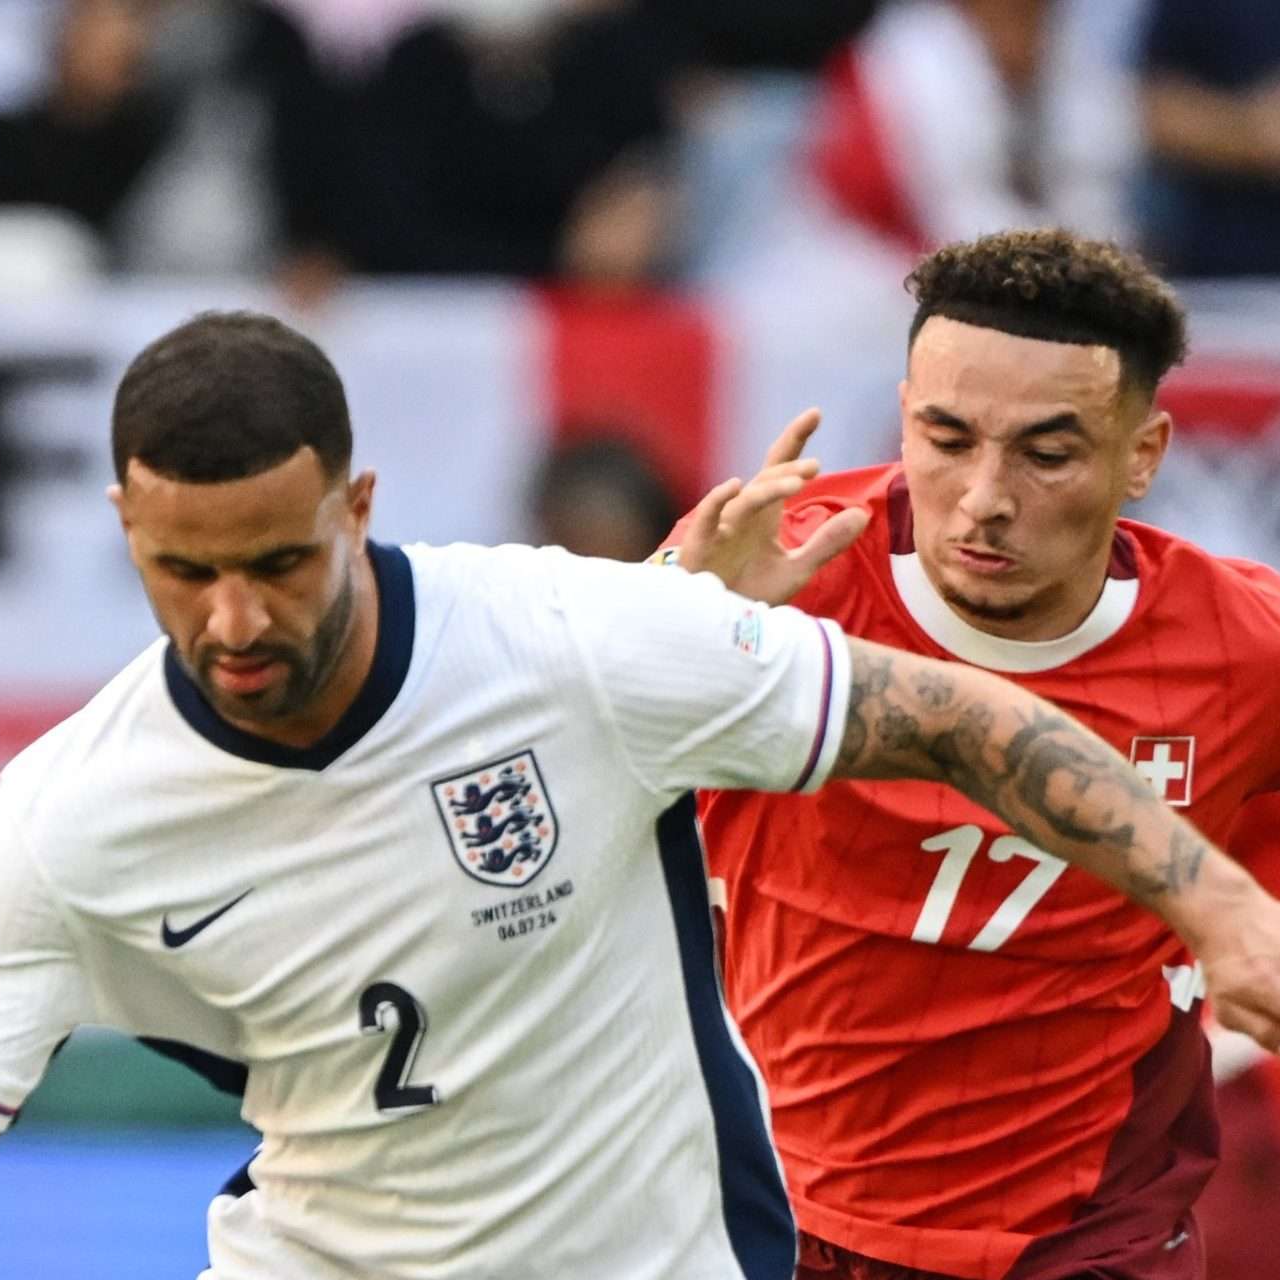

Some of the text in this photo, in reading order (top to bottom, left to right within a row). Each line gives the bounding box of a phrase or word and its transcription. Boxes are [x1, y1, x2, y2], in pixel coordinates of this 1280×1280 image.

[471, 879, 573, 927] SWITZERLAND
[910, 823, 1069, 953] 17
[358, 981, 440, 1111] 2
